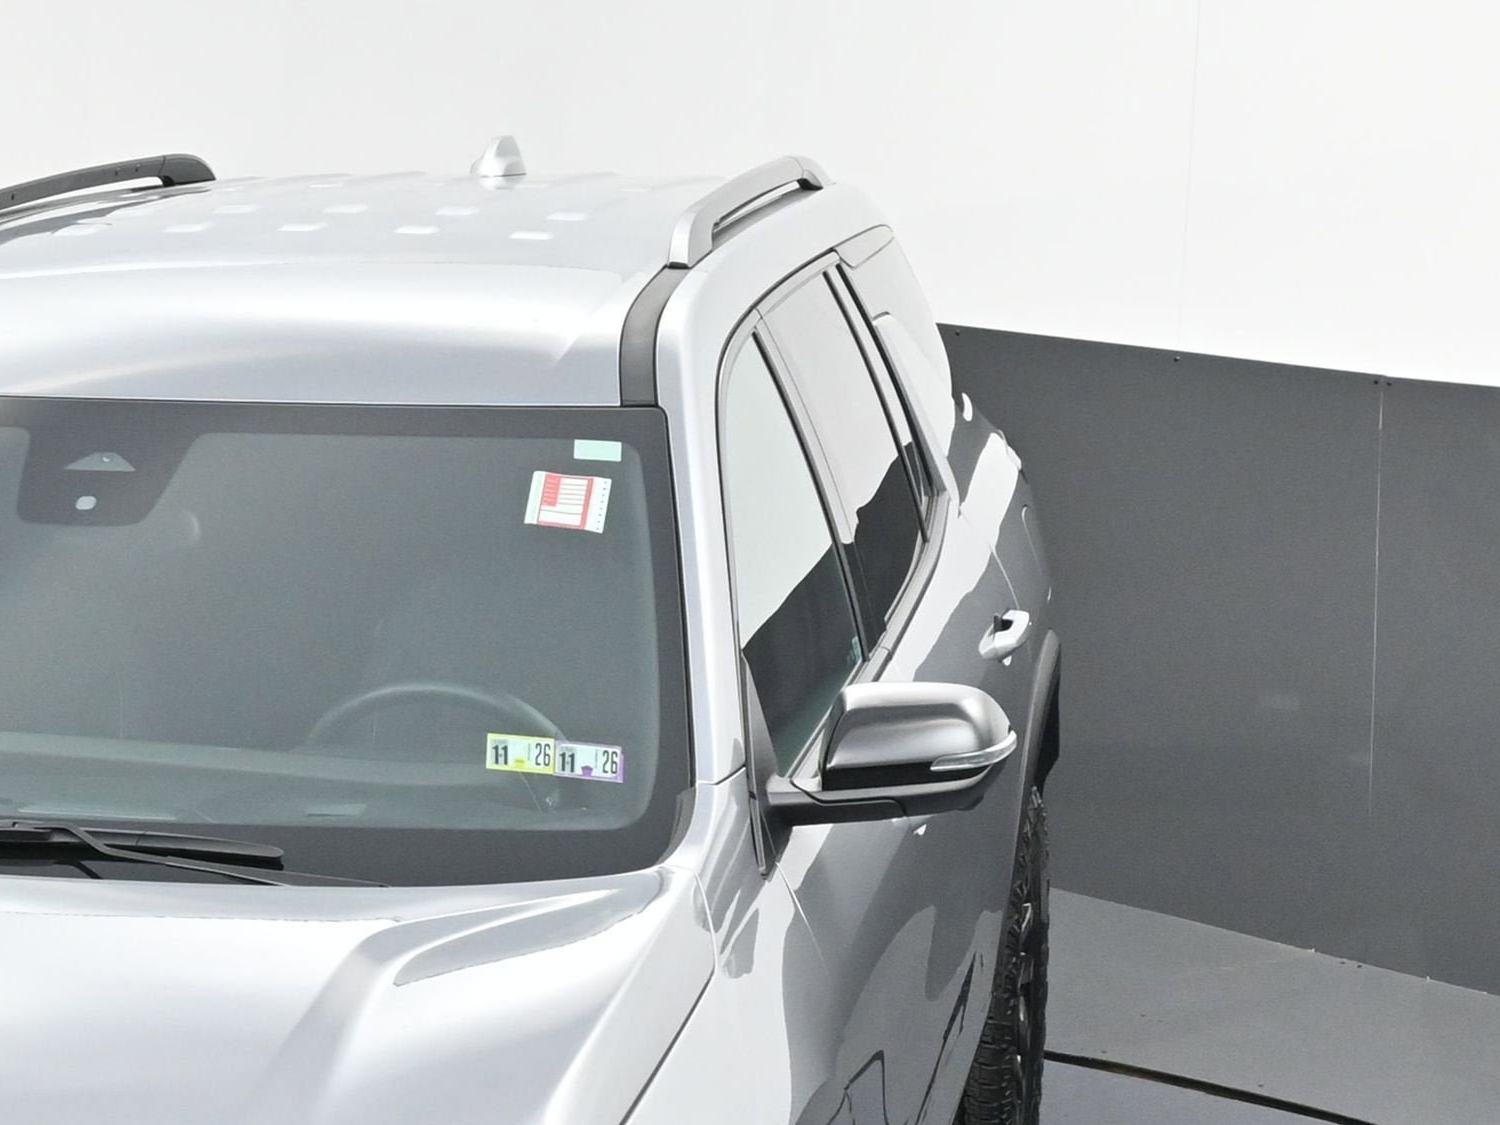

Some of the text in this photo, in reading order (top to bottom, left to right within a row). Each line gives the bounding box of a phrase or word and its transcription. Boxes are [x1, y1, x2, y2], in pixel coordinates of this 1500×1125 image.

[492, 744, 509, 766] 11
[534, 742, 551, 767] 26
[559, 751, 576, 773] 11
[602, 749, 618, 775] 26
